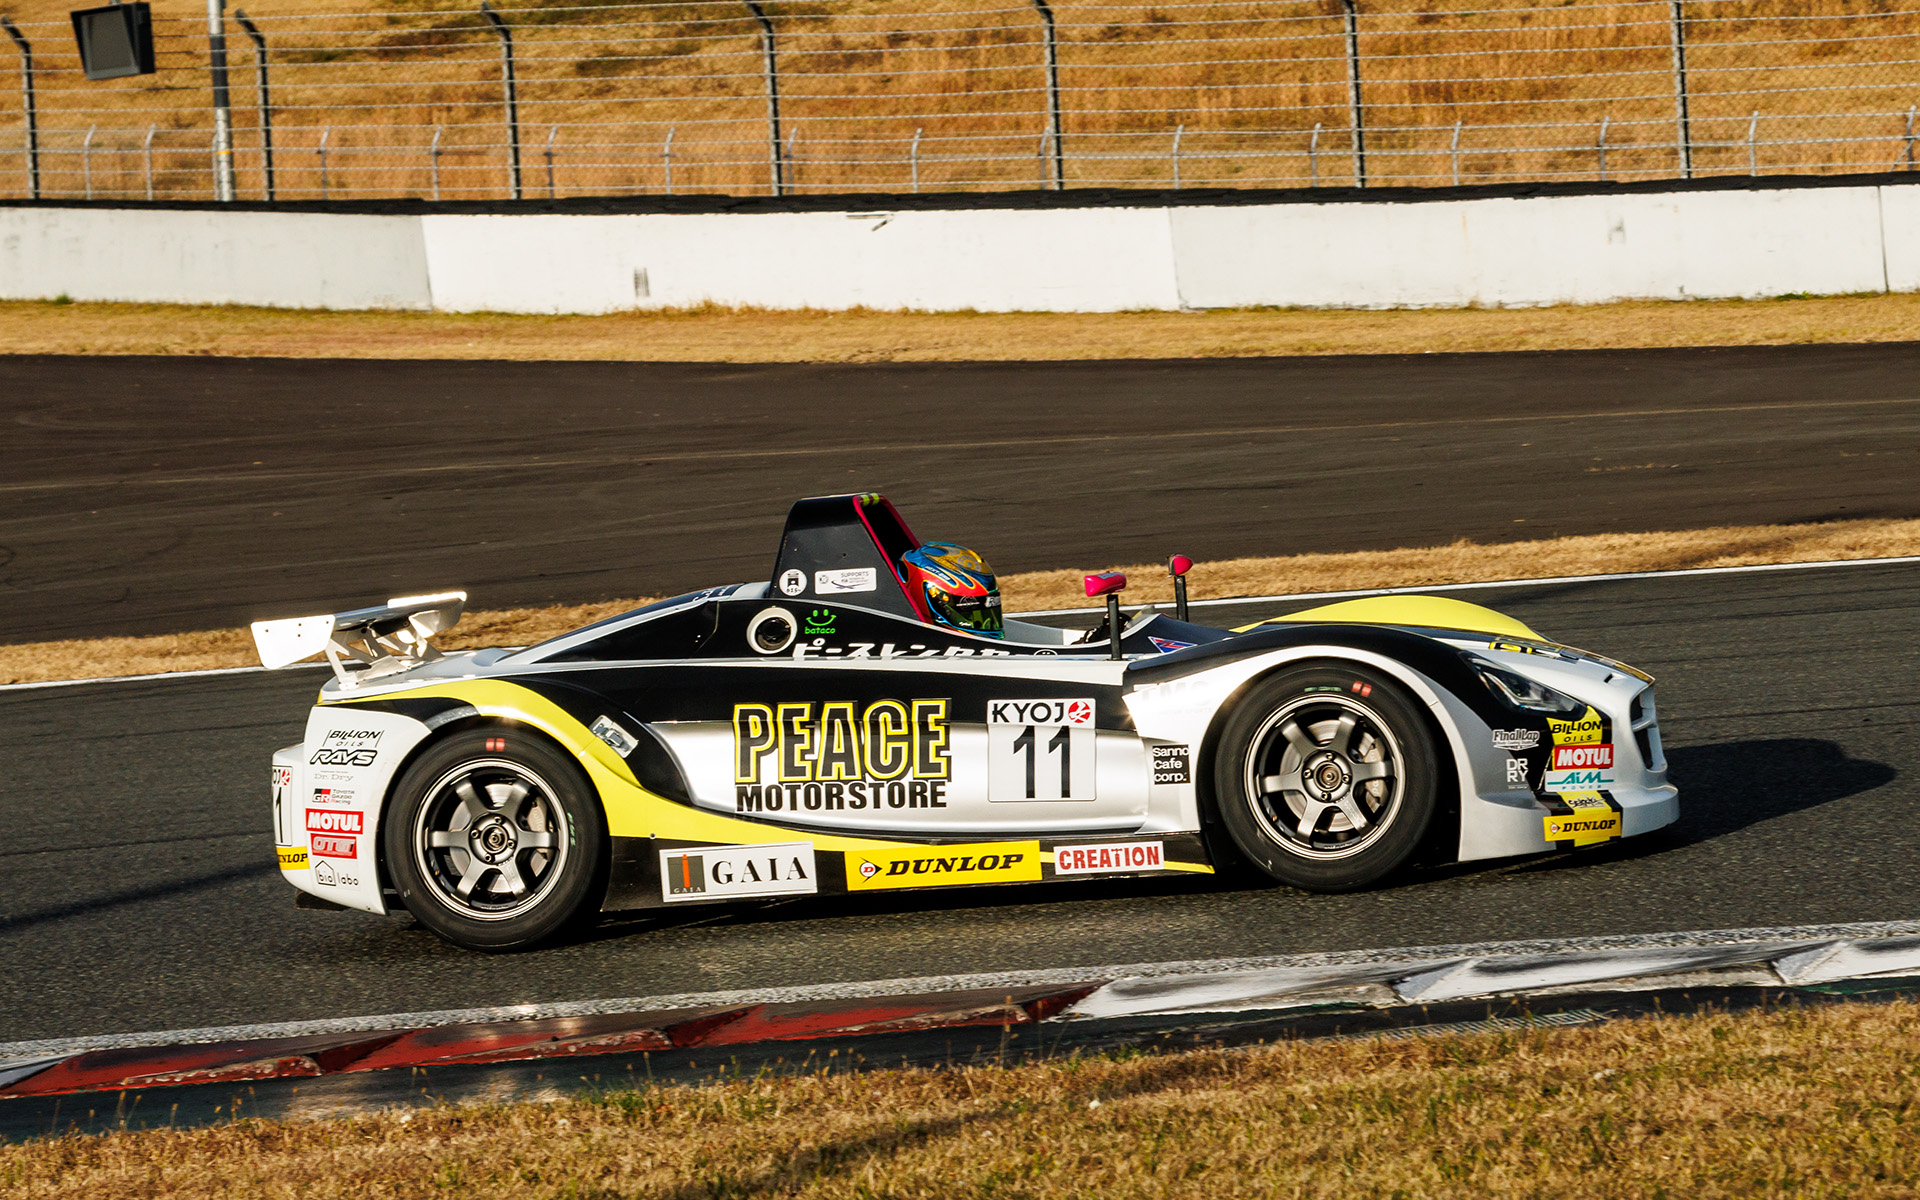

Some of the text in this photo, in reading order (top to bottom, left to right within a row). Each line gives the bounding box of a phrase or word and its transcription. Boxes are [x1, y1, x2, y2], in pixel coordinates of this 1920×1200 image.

[804, 626, 836, 634] bataco
[329, 730, 379, 740] BILLION
[1552, 721, 1601, 735] BILLION
[733, 699, 951, 782] PEACE
[1563, 734, 1592, 743] OILS
[310, 749, 377, 766] RAYS
[1153, 747, 1189, 757] Sanno
[1557, 748, 1611, 766] MOTUL
[1013, 725, 1070, 799] 11
[331, 774, 354, 782] Dry
[312, 794, 330, 803] GR
[736, 782, 947, 811] MOTORSTORE
[307, 811, 361, 830] MOTUL
[1562, 820, 1616, 832] DUNLOP
[886, 854, 1023, 876] DUNLOP
[1058, 847, 1160, 870] CREATION
[317, 870, 358, 885] bio labo
[712, 857, 808, 884] GAIA
